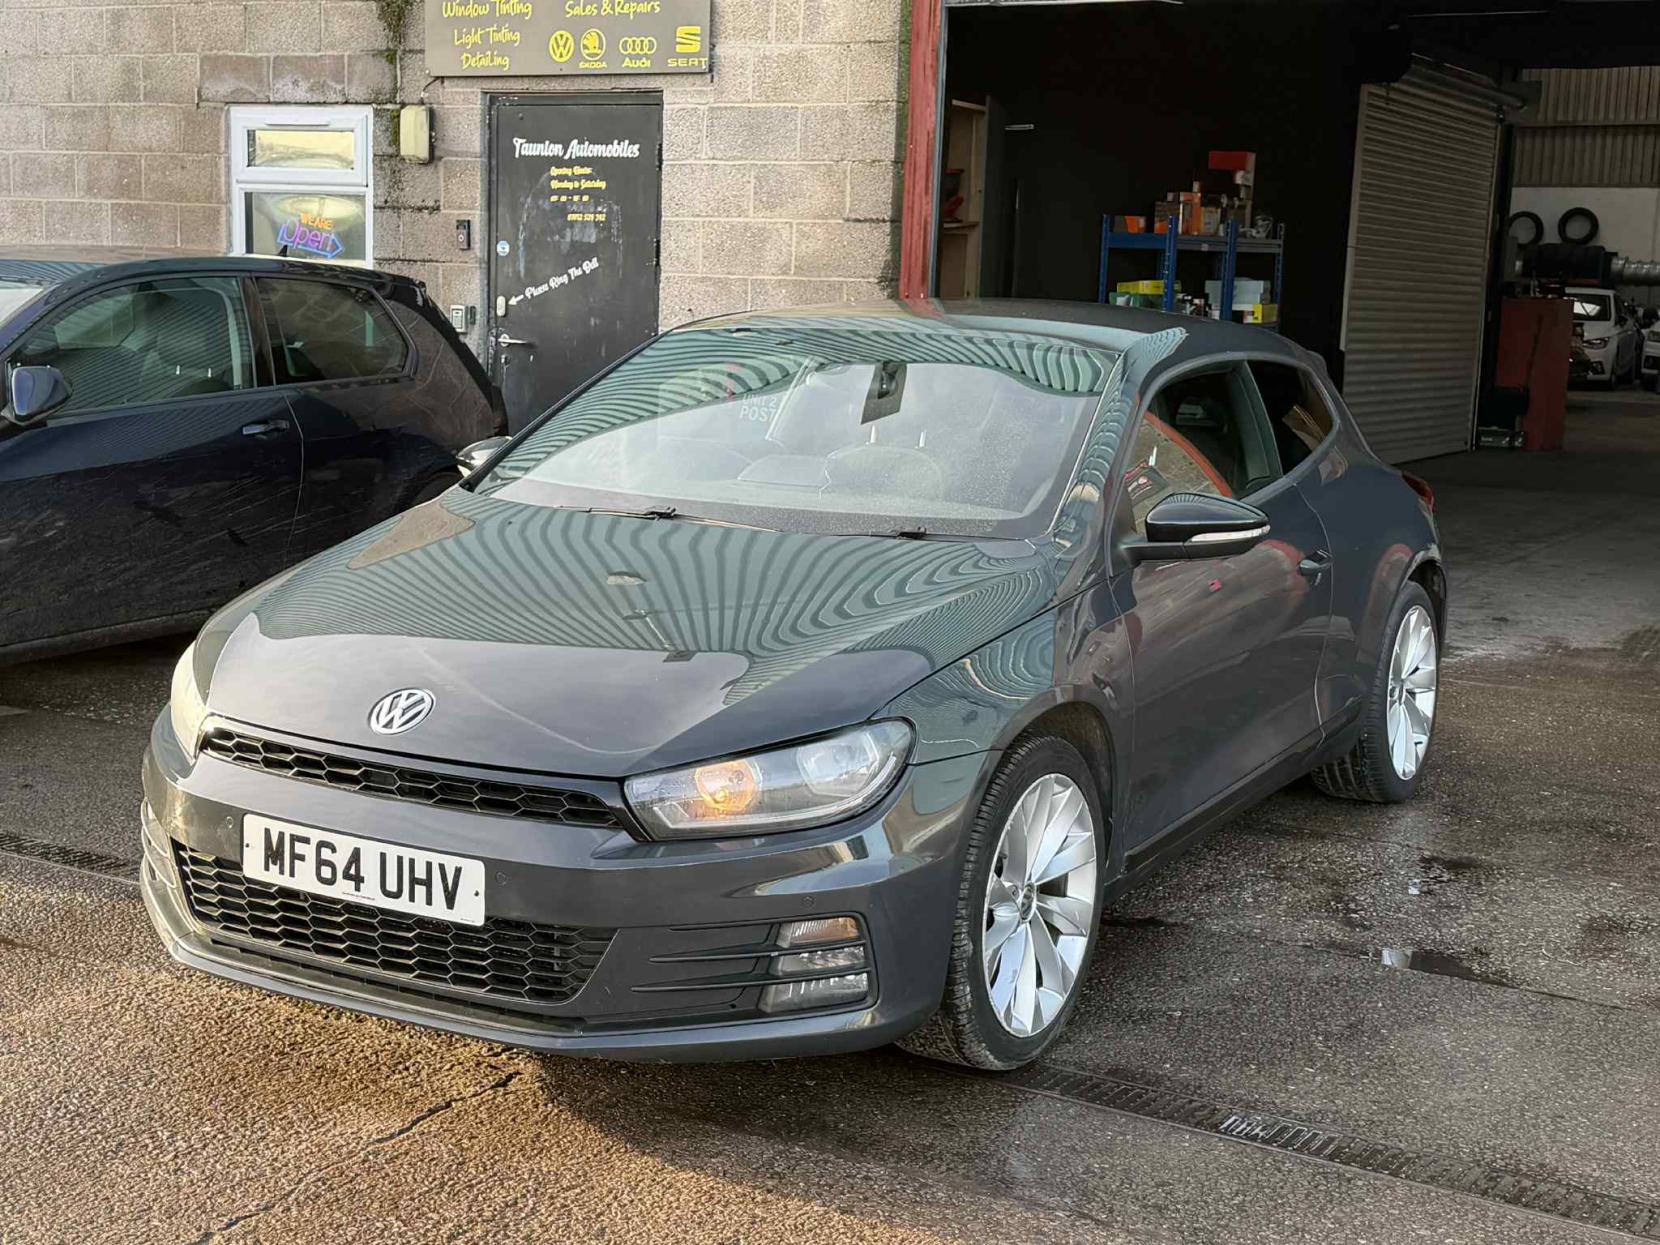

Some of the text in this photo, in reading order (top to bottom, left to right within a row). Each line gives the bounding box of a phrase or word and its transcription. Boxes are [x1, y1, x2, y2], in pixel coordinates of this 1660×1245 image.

[442, 0, 532, 20] Window Tinting
[565, 0, 660, 20] Sales & Repairs
[454, 23, 520, 49] Light Tinting
[461, 50, 509, 71] Detailing
[622, 57, 651, 68] Audi
[667, 58, 708, 68] SEAT
[512, 137, 640, 160] Taunton Automobiles
[284, 217, 333, 251] Open
[524, 257, 599, 299] Please Ring The Bell
[739, 405, 777, 422] POST
[263, 827, 462, 910] MF64 UHV
